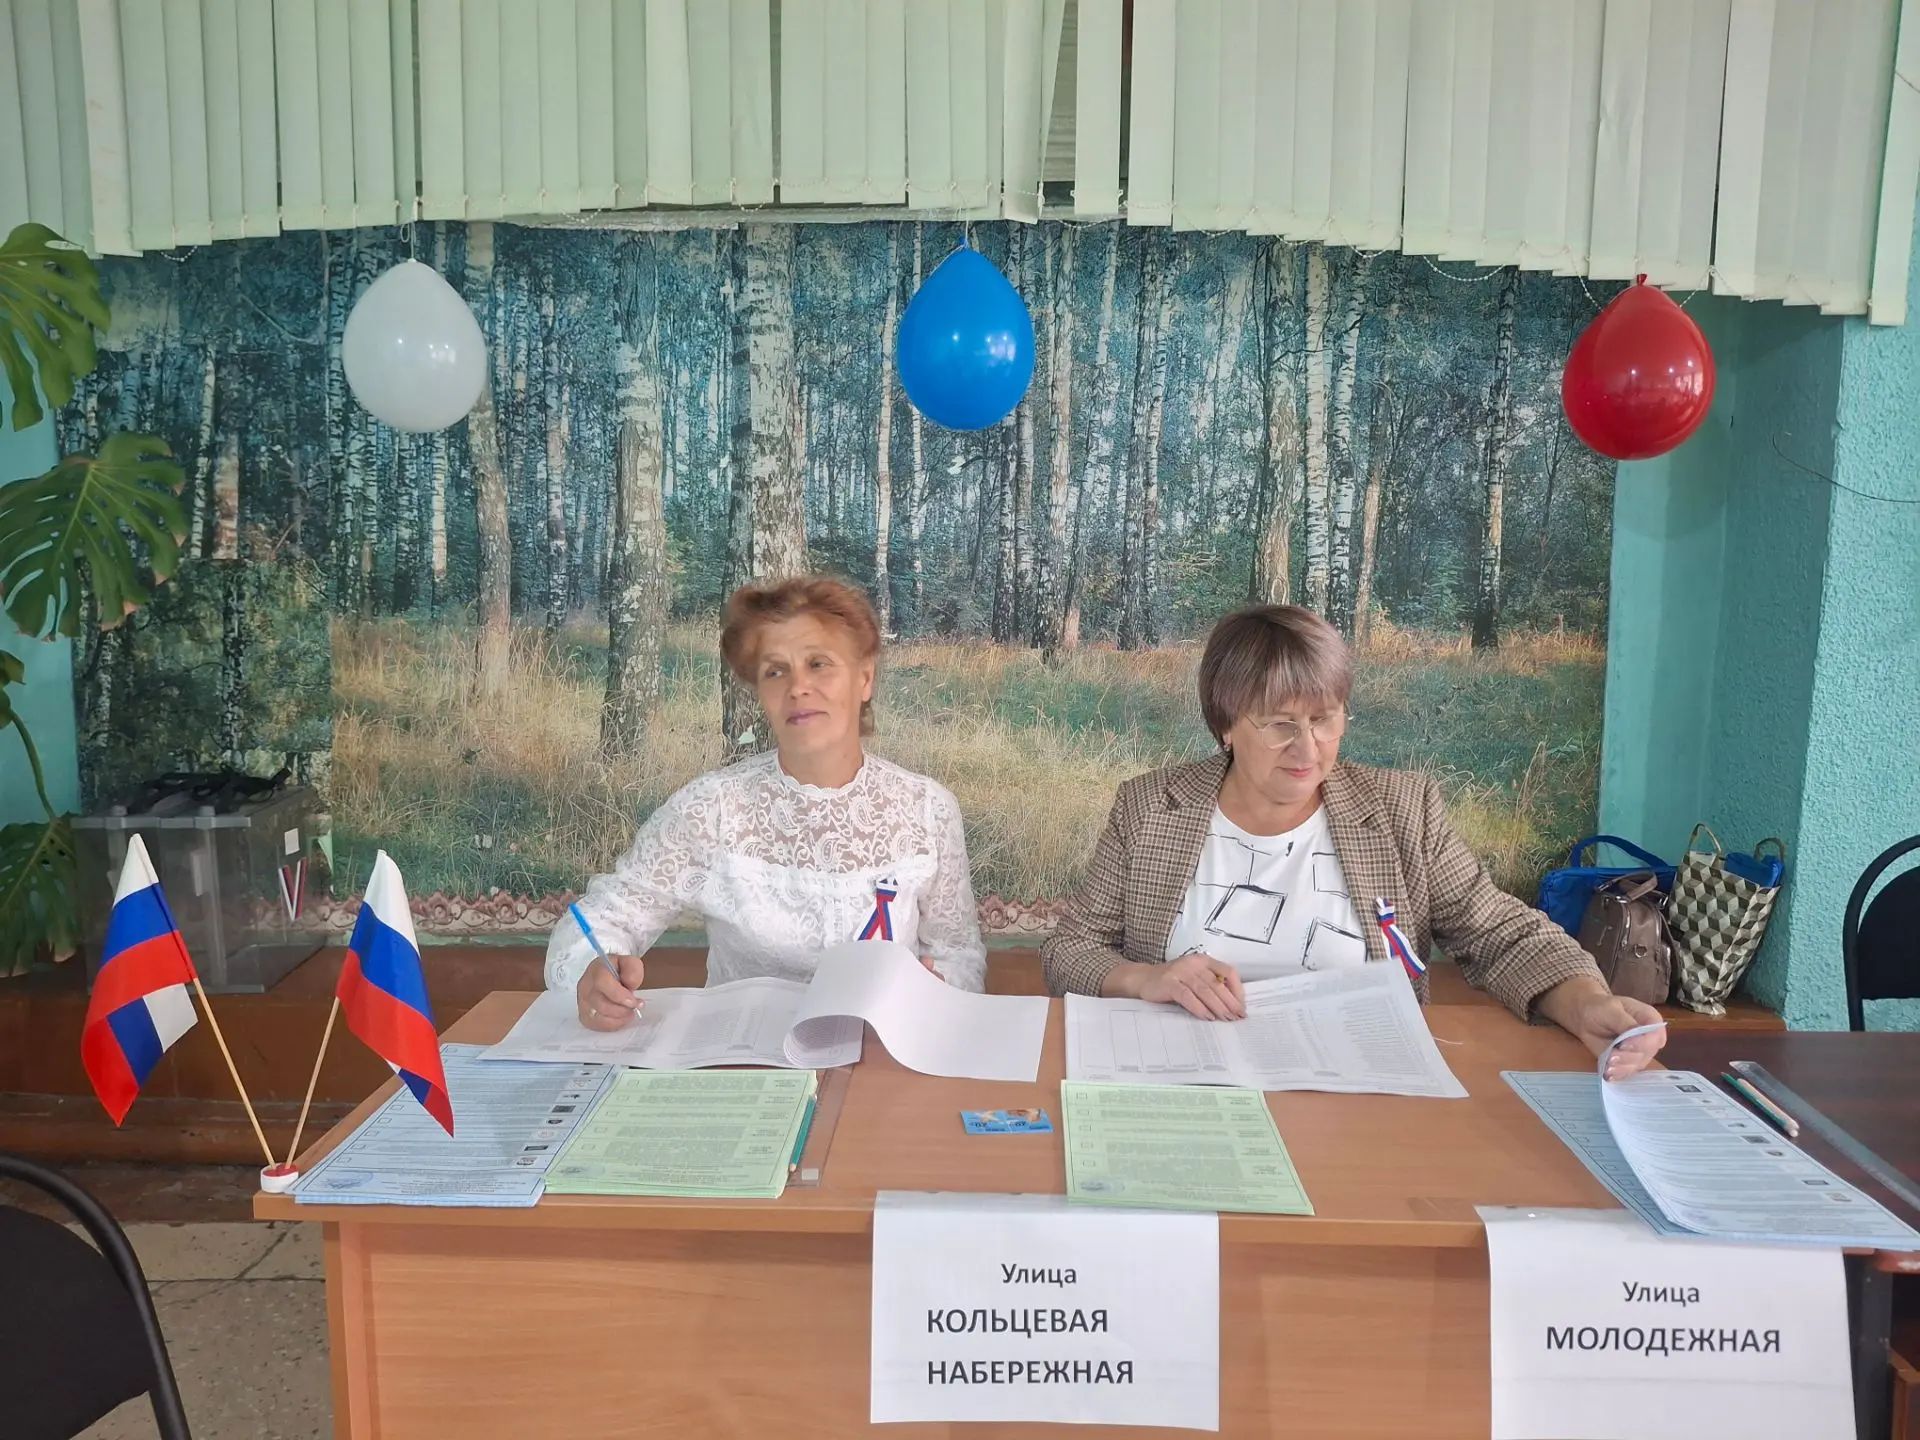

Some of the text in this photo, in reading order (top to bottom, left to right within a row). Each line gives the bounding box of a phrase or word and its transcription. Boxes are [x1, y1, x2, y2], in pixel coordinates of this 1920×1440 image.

[1001, 1263, 1077, 1288] Улица
[1622, 1281, 1700, 1307] Улица
[927, 1309, 1108, 1338] КОЛЬЦЕВАЯ
[1546, 1326, 1781, 1357] МОЛОДЕЖНАЯ
[928, 1360, 1134, 1385] НАБЕРЕЖНАЯ
